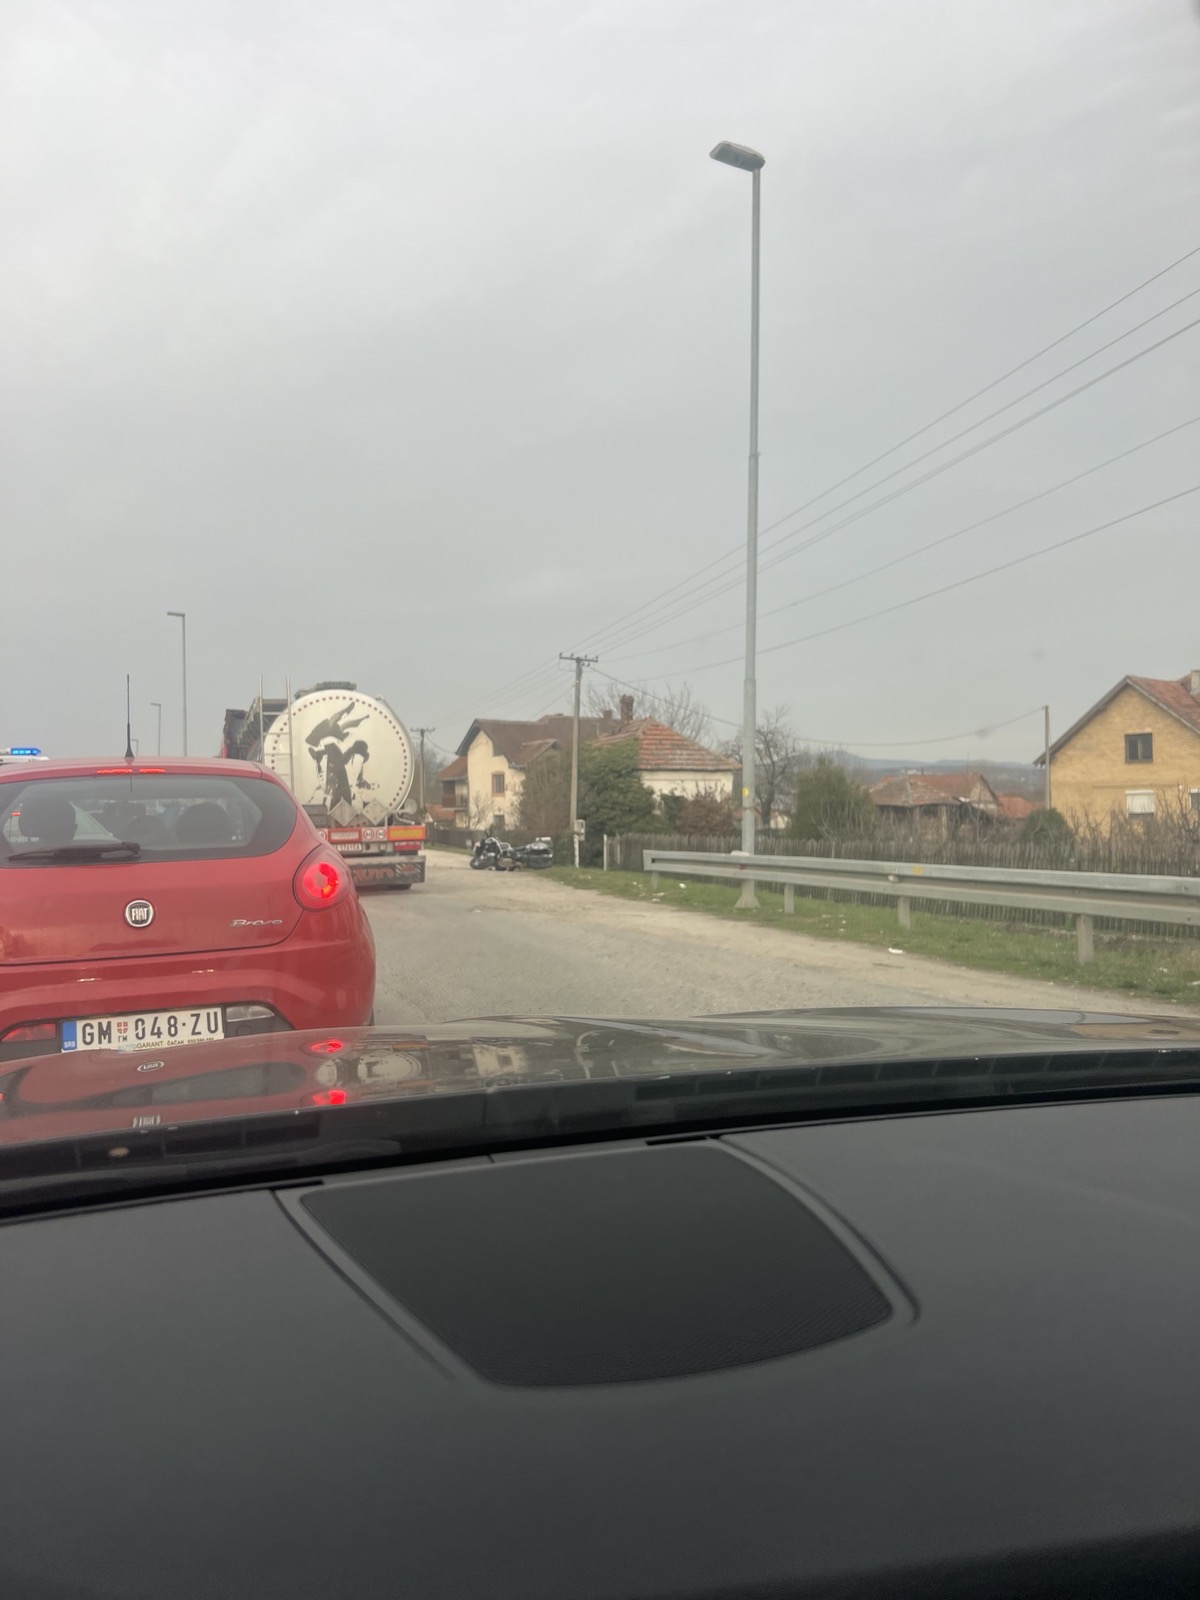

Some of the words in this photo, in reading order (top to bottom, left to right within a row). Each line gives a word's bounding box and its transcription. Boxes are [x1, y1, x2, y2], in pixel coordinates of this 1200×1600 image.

[131, 907, 148, 921] FIAT
[82, 1020, 112, 1046] GM
[63, 1040, 76, 1049] SRB
